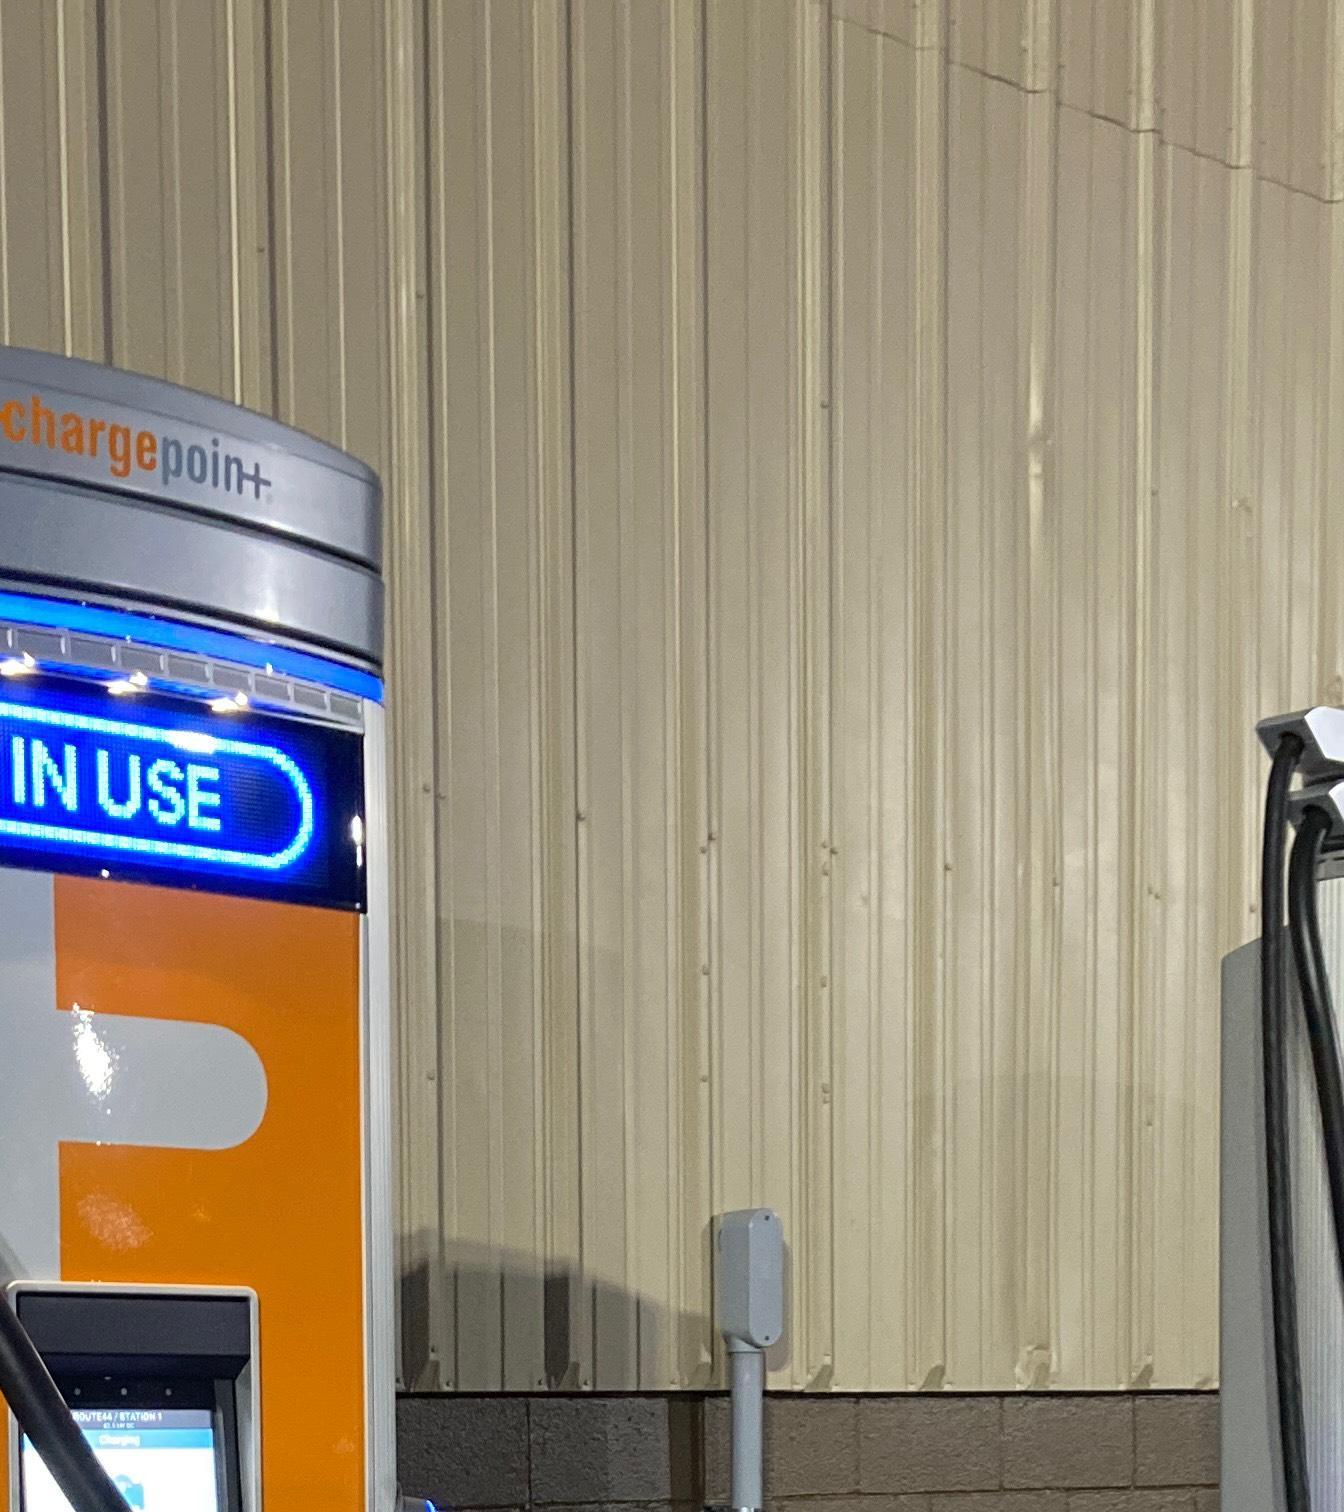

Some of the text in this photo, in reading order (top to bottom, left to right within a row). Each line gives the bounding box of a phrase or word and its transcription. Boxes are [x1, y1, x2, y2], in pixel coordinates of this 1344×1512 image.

[12, 736, 222, 831] IN USE
[119, 1411, 156, 1421] STATION
